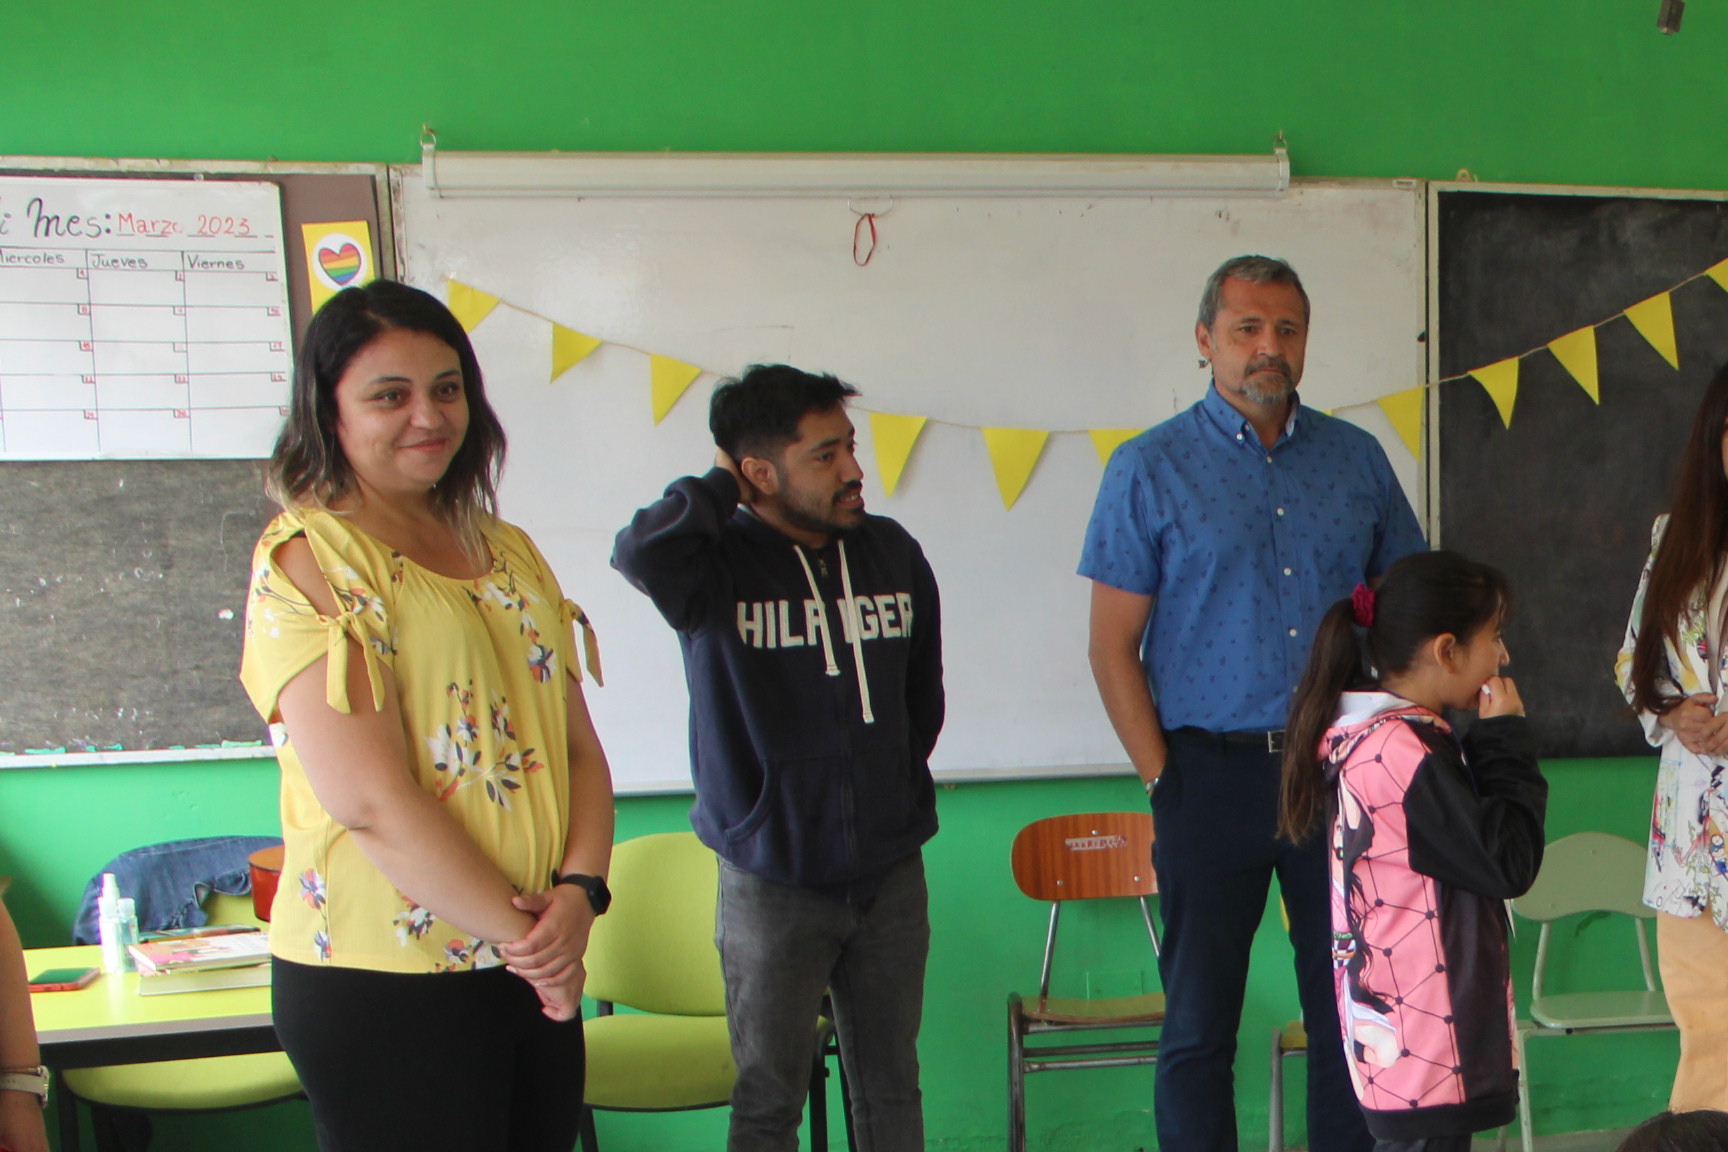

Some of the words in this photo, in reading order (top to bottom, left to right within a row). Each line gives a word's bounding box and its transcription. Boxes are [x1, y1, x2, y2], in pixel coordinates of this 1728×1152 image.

[197, 213, 252, 235] 2023
[90, 253, 148, 269] Jueves
[187, 254, 245, 270] Viernes
